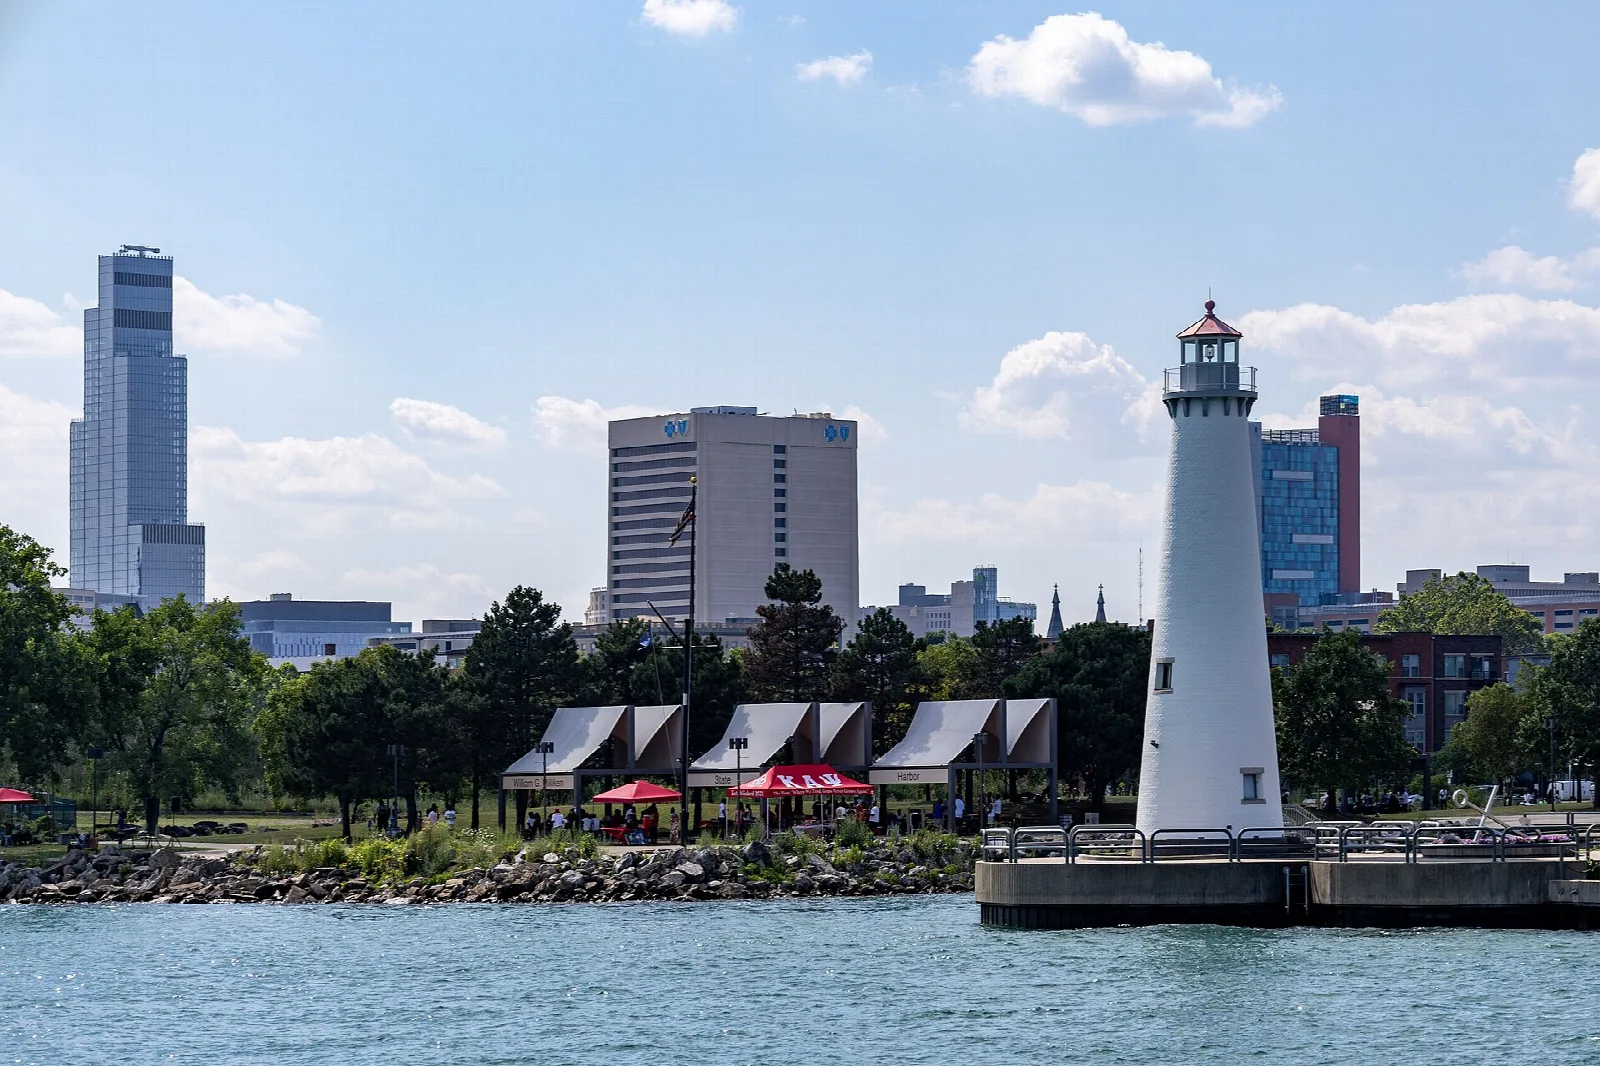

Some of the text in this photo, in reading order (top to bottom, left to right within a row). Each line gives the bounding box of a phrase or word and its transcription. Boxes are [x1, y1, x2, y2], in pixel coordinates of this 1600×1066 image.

[714, 775, 731, 784] State
[897, 772, 920, 781] Harbor
[513, 779, 564, 787] William G. illiken
